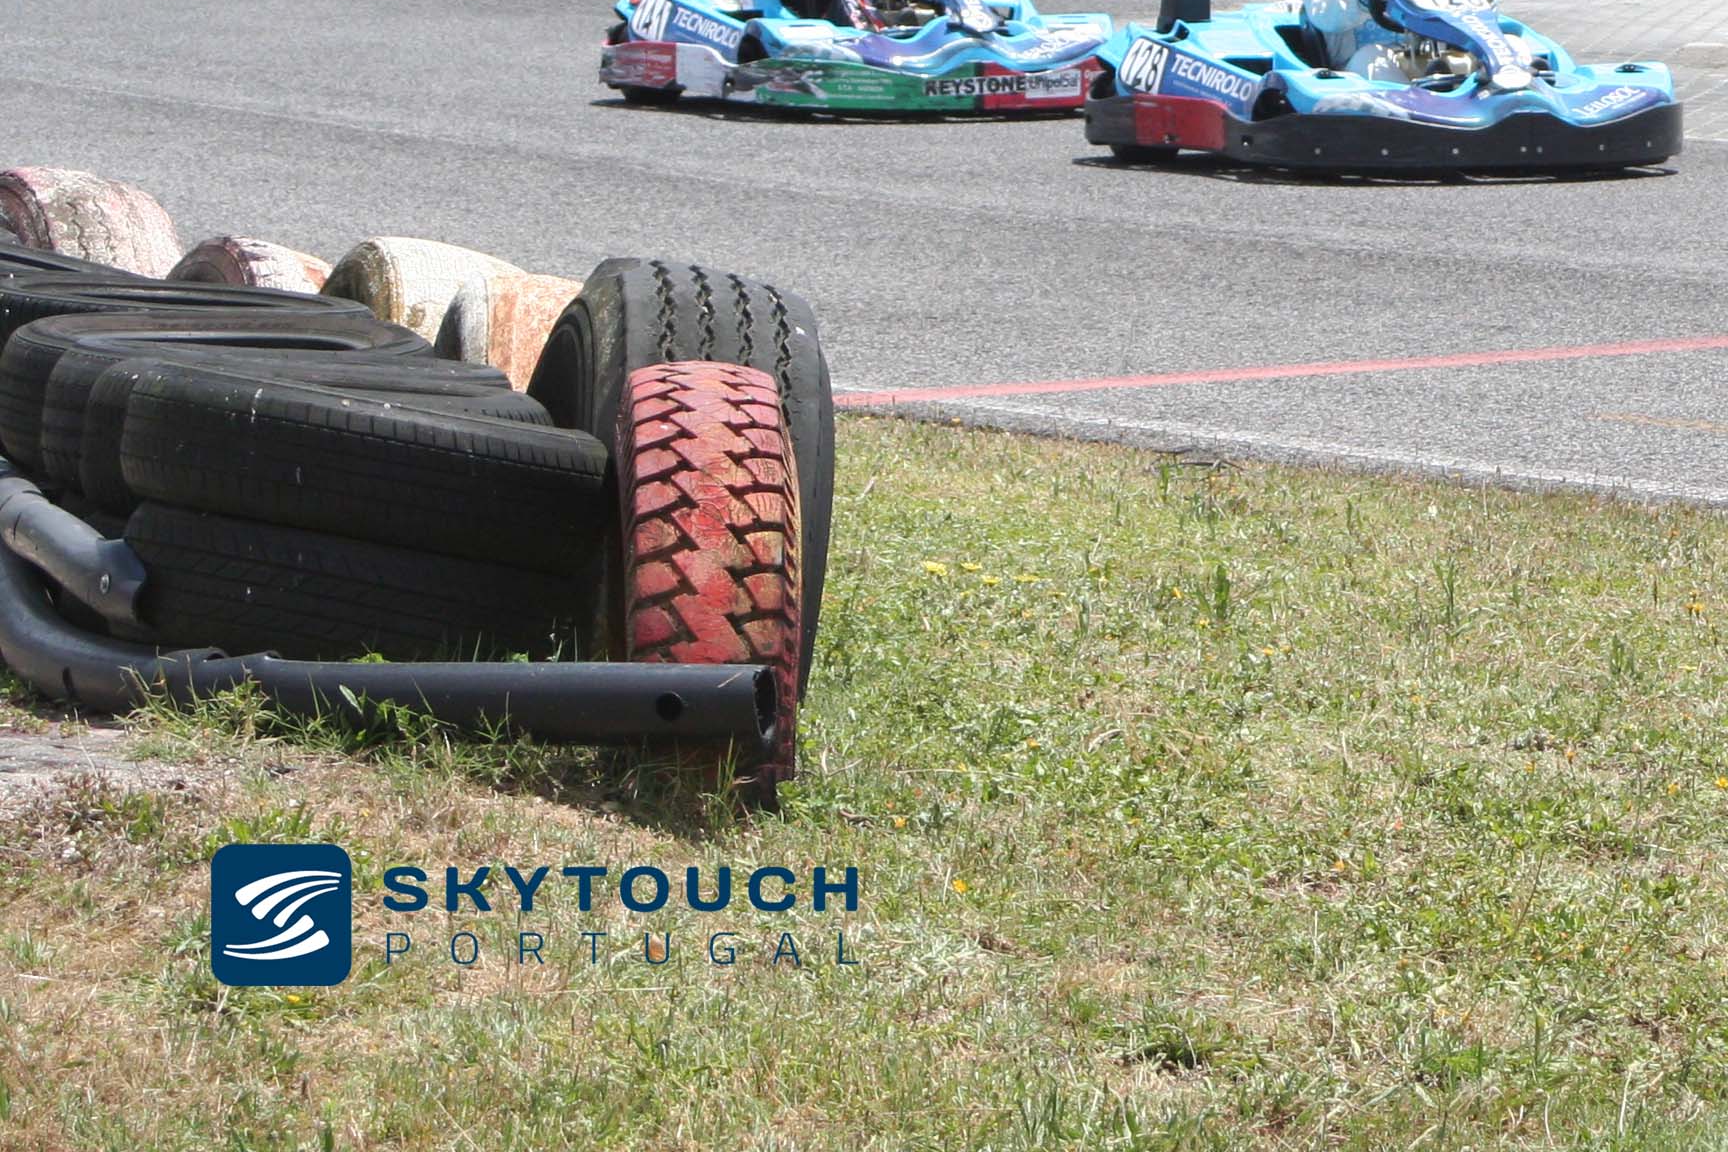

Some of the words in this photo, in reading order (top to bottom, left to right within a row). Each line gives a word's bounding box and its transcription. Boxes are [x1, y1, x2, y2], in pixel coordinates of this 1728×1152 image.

[672, 6, 742, 49] TECNIROLO
[925, 76, 1025, 96] KEYSTONE
[1171, 53, 1253, 101] TECNIROLO
